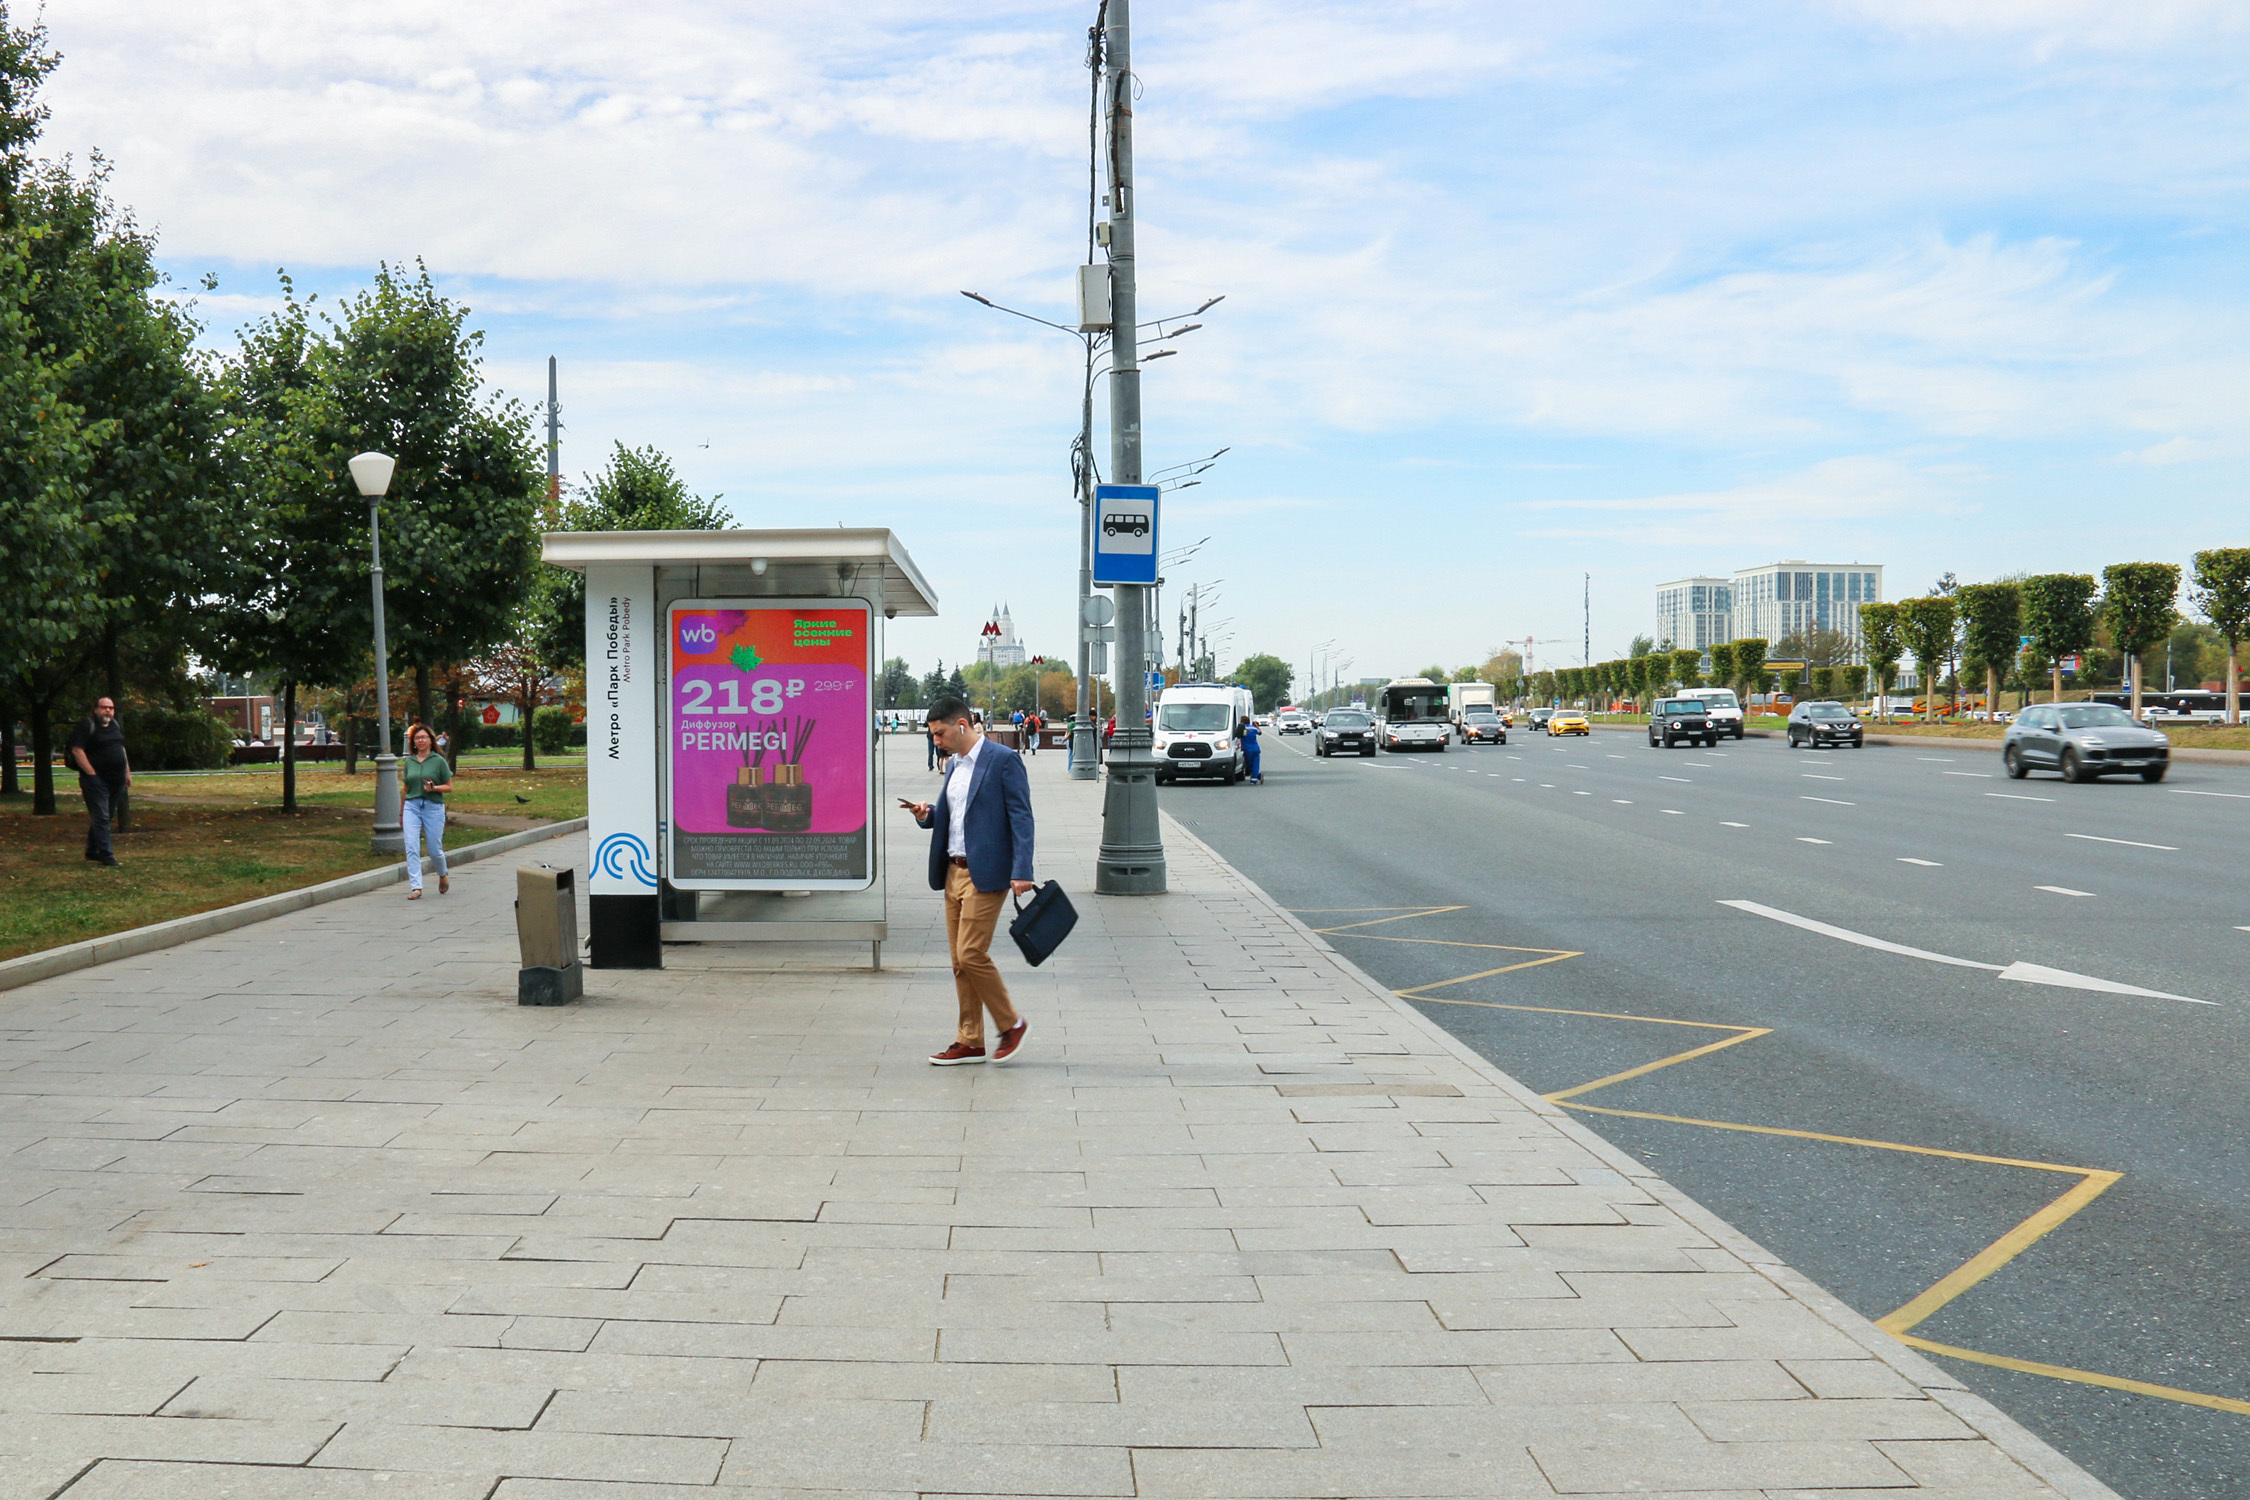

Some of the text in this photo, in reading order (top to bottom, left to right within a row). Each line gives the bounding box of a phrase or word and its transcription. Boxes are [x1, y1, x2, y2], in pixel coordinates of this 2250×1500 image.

[793, 618, 837, 629] Яркие
[681, 623, 716, 643] wb
[793, 629, 853, 638] осенние
[622, 596, 632, 683] Metro Park Pobedy
[793, 638, 831, 647] цены
[606, 597, 621, 760] Метро «Парк Победы»
[814, 680, 842, 691] 299
[681, 720, 736, 730] Диффузор
[682, 732, 787, 750] PERMEGI
